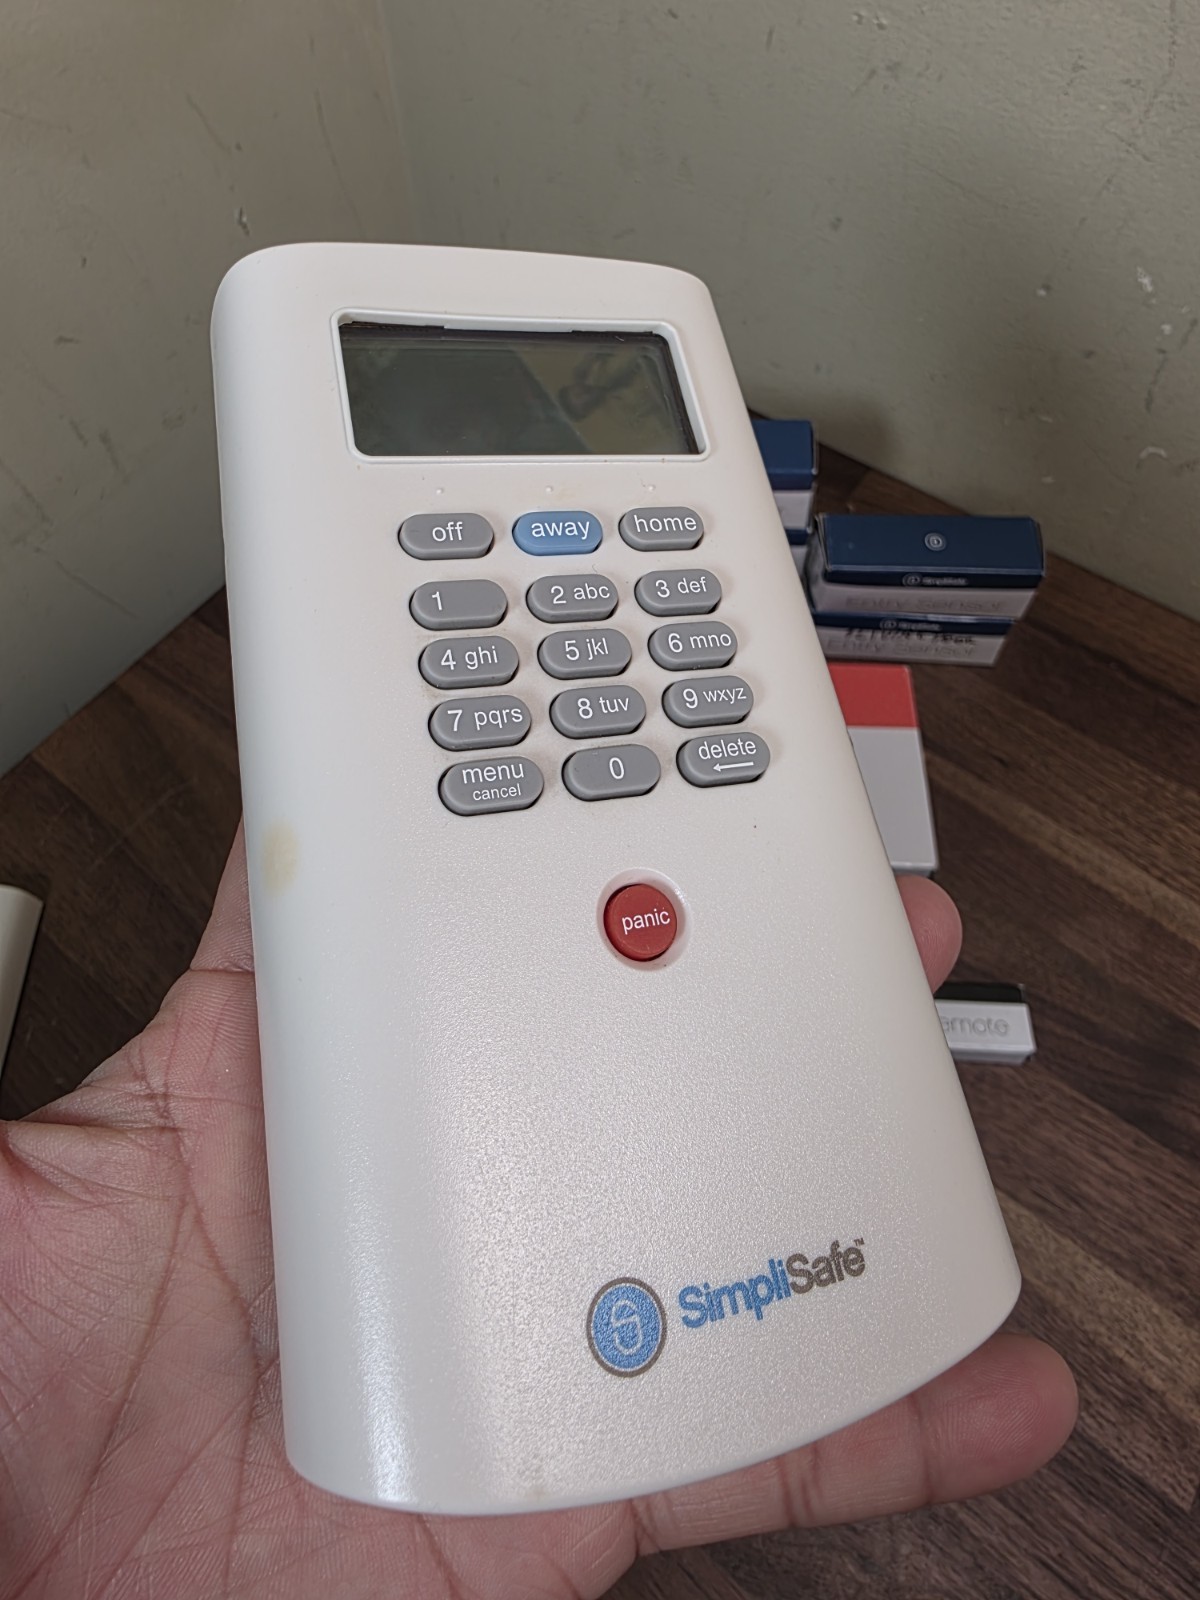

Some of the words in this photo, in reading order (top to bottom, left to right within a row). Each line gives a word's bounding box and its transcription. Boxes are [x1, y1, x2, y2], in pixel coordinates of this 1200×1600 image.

[431, 521, 464, 542] off
[531, 518, 591, 541] away
[633, 513, 698, 533] home
[550, 585, 567, 605] 2
[573, 582, 611, 600] abc
[655, 579, 671, 598] 3
[676, 576, 708, 595] def
[431, 591, 444, 611] 1
[564, 640, 581, 661] 5
[586, 637, 610, 659] jkl
[667, 632, 684, 653] 6
[689, 632, 732, 650] mno
[440, 649, 457, 670] 4
[465, 645, 499, 670] ghi
[577, 698, 594, 719] 8
[598, 695, 631, 714] tuv
[682, 688, 699, 709] 9
[702, 685, 747, 706] wxyz
[447, 709, 464, 732] 7
[474, 707, 524, 731] pqrs
[697, 738, 758, 760] delete
[461, 760, 525, 784] menu
[608, 757, 625, 780] 0
[472, 783, 522, 801] cancel
[621, 908, 671, 935] panic
[940, 1016, 1010, 1038] emote
